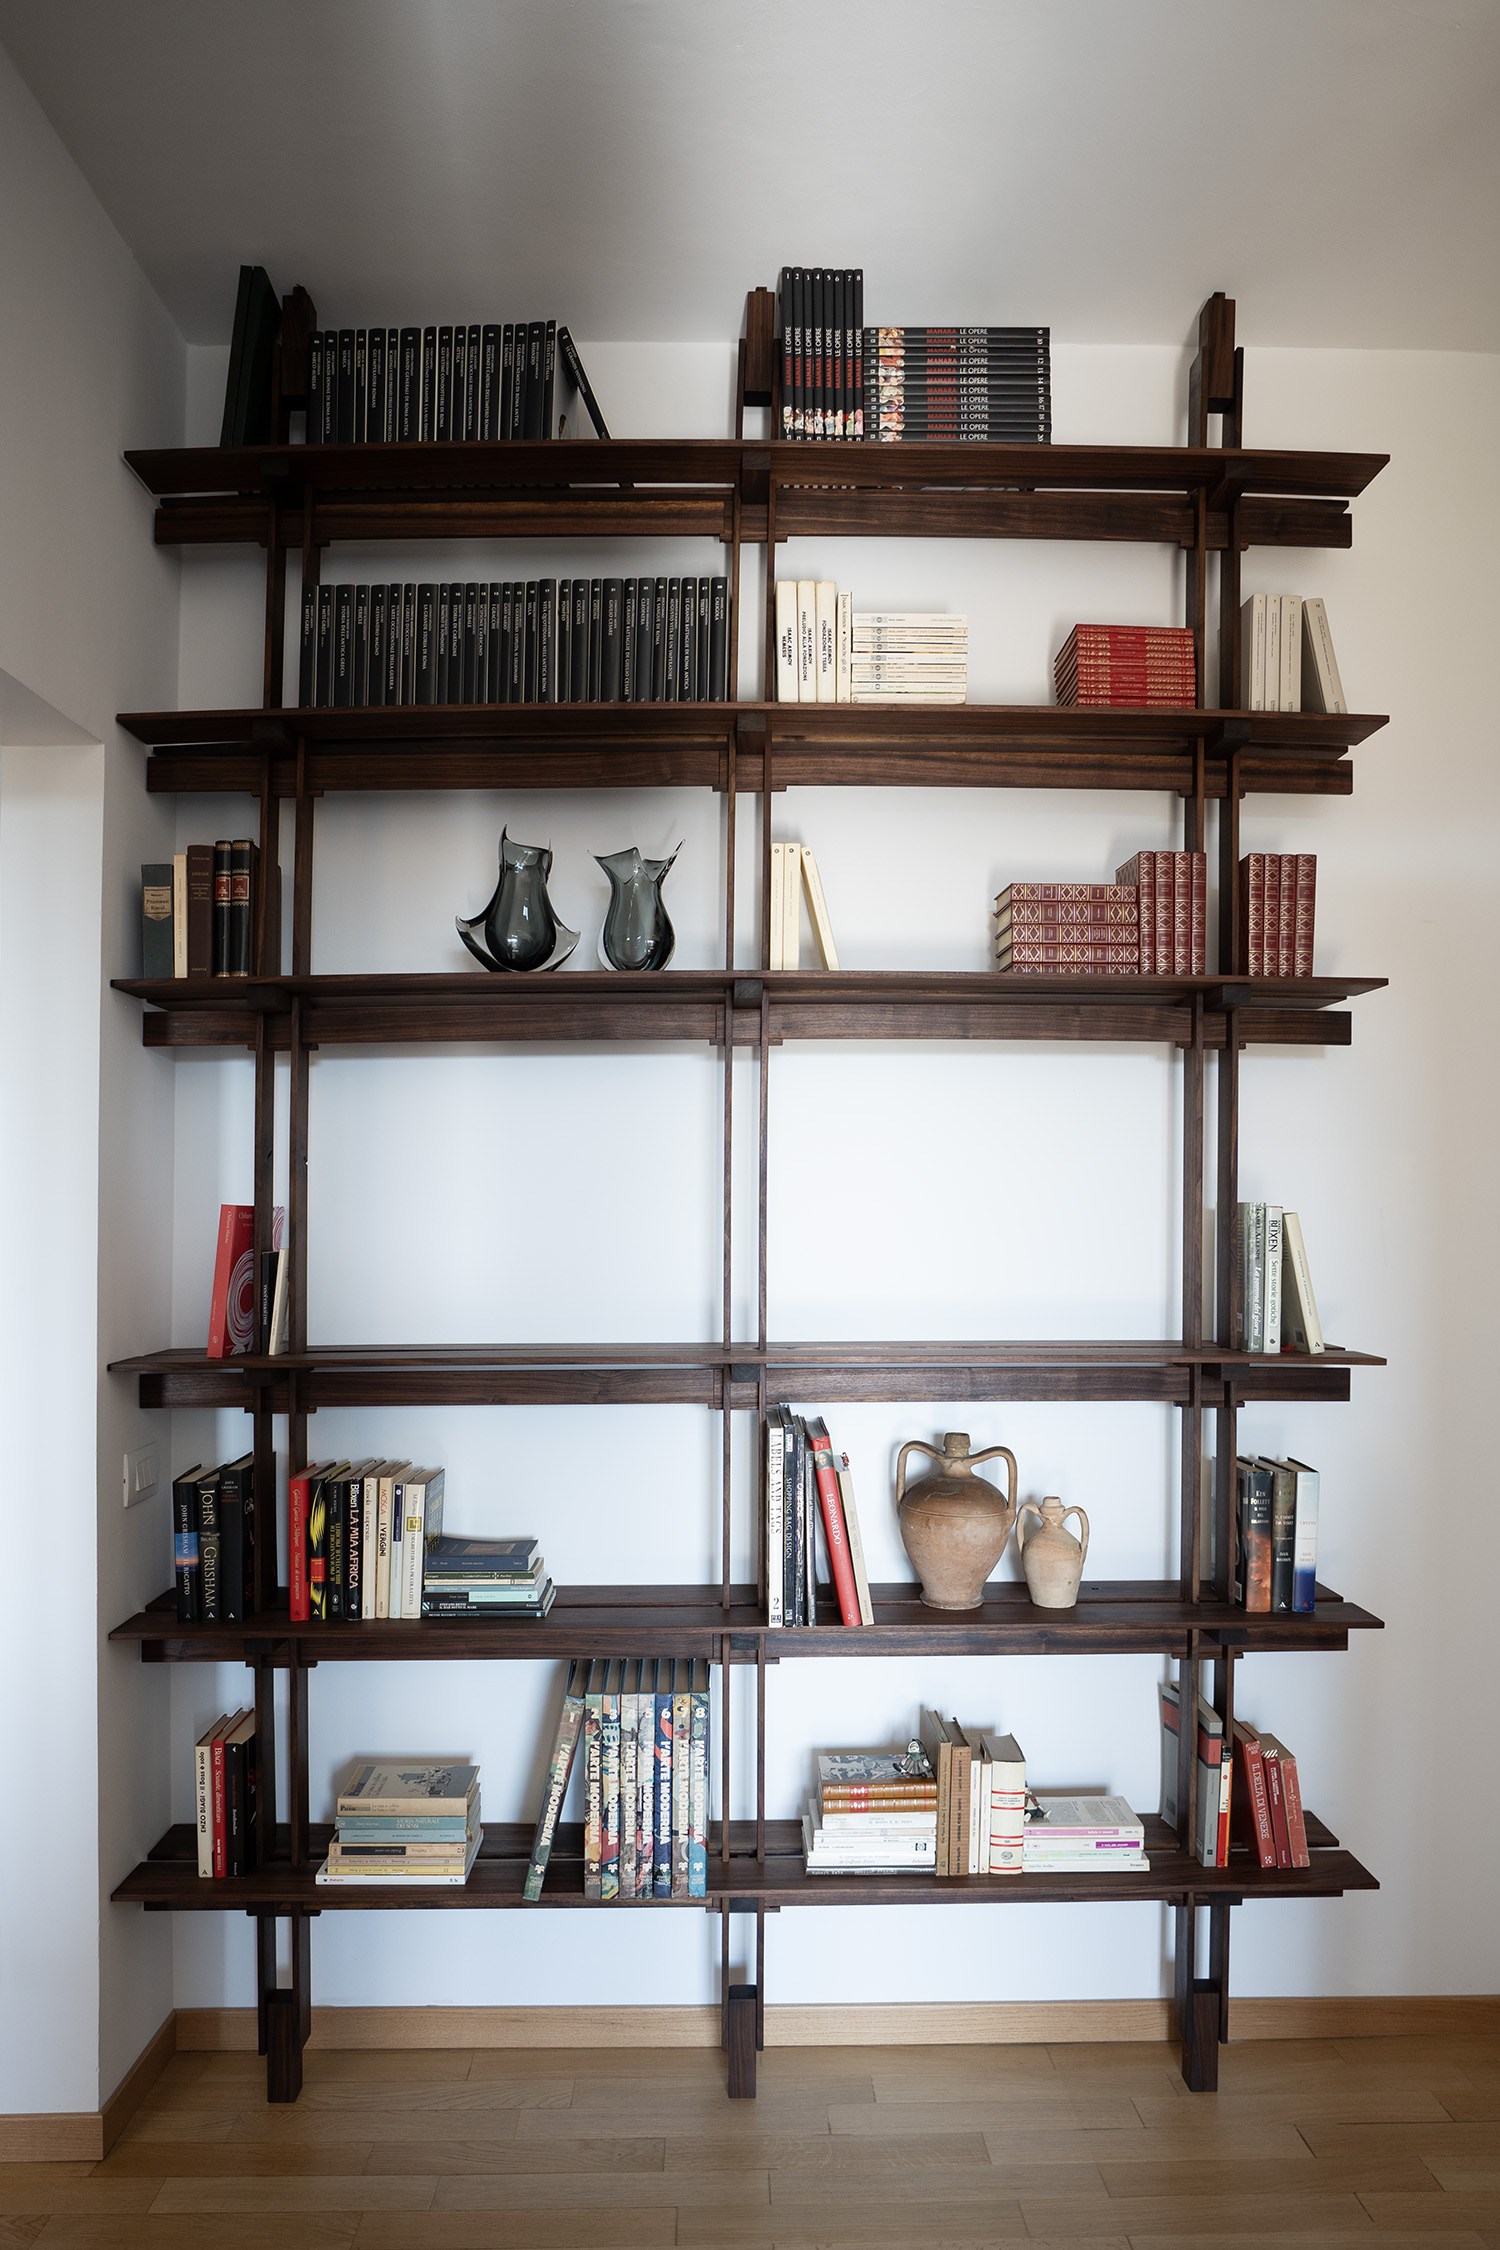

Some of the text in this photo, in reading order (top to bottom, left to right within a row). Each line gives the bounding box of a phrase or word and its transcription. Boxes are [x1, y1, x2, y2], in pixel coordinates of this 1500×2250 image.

[1268, 1220, 1278, 1252] BLIXEN
[1255, 1267, 1261, 1276] La
[1252, 1315, 1260, 1337] giorni
[1270, 1300, 1278, 1324] gotiche
[771, 1434, 781, 1534] LABELS AND TAGS
[785, 1478, 793, 1514] SHOPPING
[350, 1484, 359, 1588] Blixen LA MIA AFRICA
[826, 1493, 841, 1545] LEONARDO
[200, 1489, 218, 1607] JOHN GRISHAM
[773, 1597, 779, 1610] 2
[591, 1709, 599, 1719] 2
[609, 1709, 617, 1720] 3
[661, 1708, 670, 1718] 6
[695, 1707, 705, 1718] 8
[589, 1782, 600, 1845] MODERNA
[608, 1783, 618, 1845] MODERNA
[659, 1782, 670, 1845] MODERNA
[693, 1781, 704, 1844] MODERNA
[1252, 1763, 1269, 1840] IL DELTA DI VENERE
